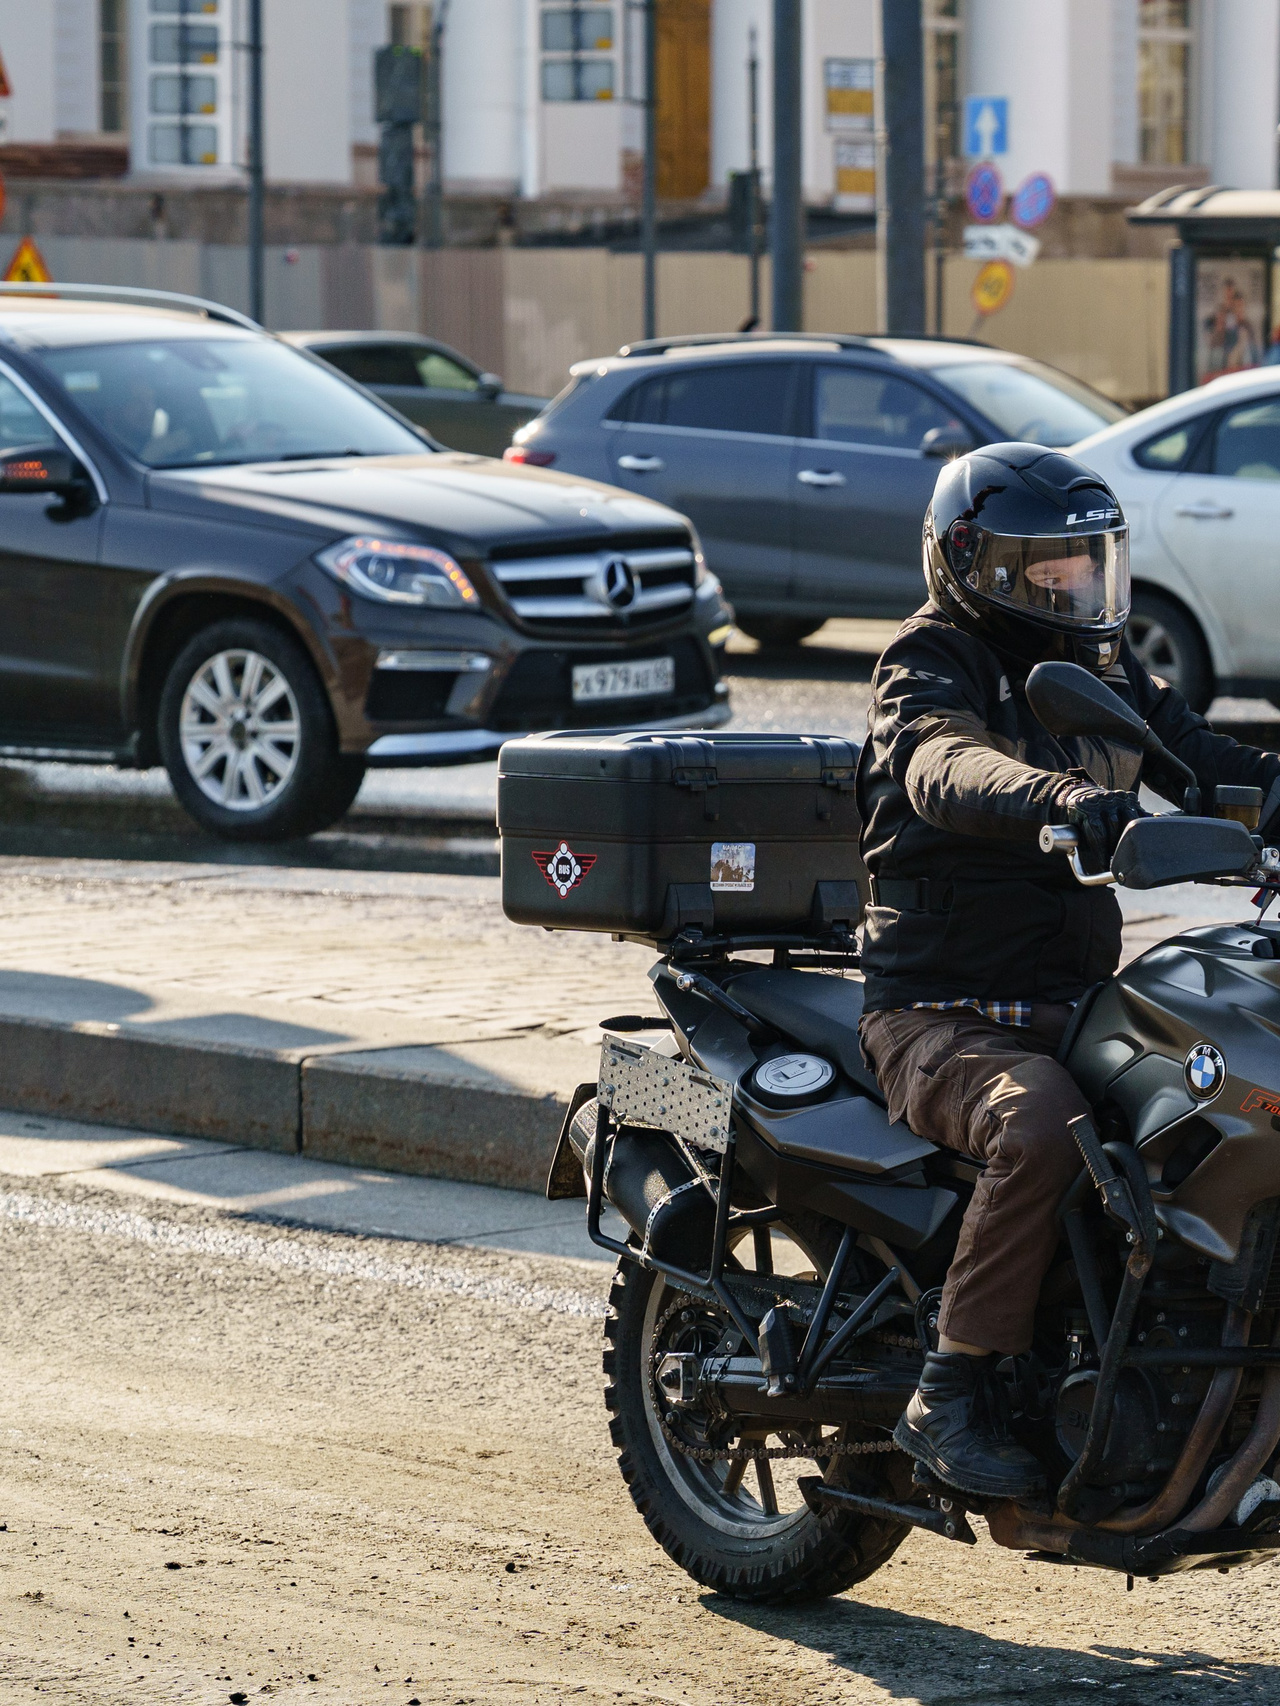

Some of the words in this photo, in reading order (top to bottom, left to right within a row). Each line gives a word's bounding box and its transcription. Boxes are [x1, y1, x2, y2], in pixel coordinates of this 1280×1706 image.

[1066, 508, 1120, 526] LS2
[558, 864, 571, 875] RUS
[1190, 1045, 1224, 1067] BMW
